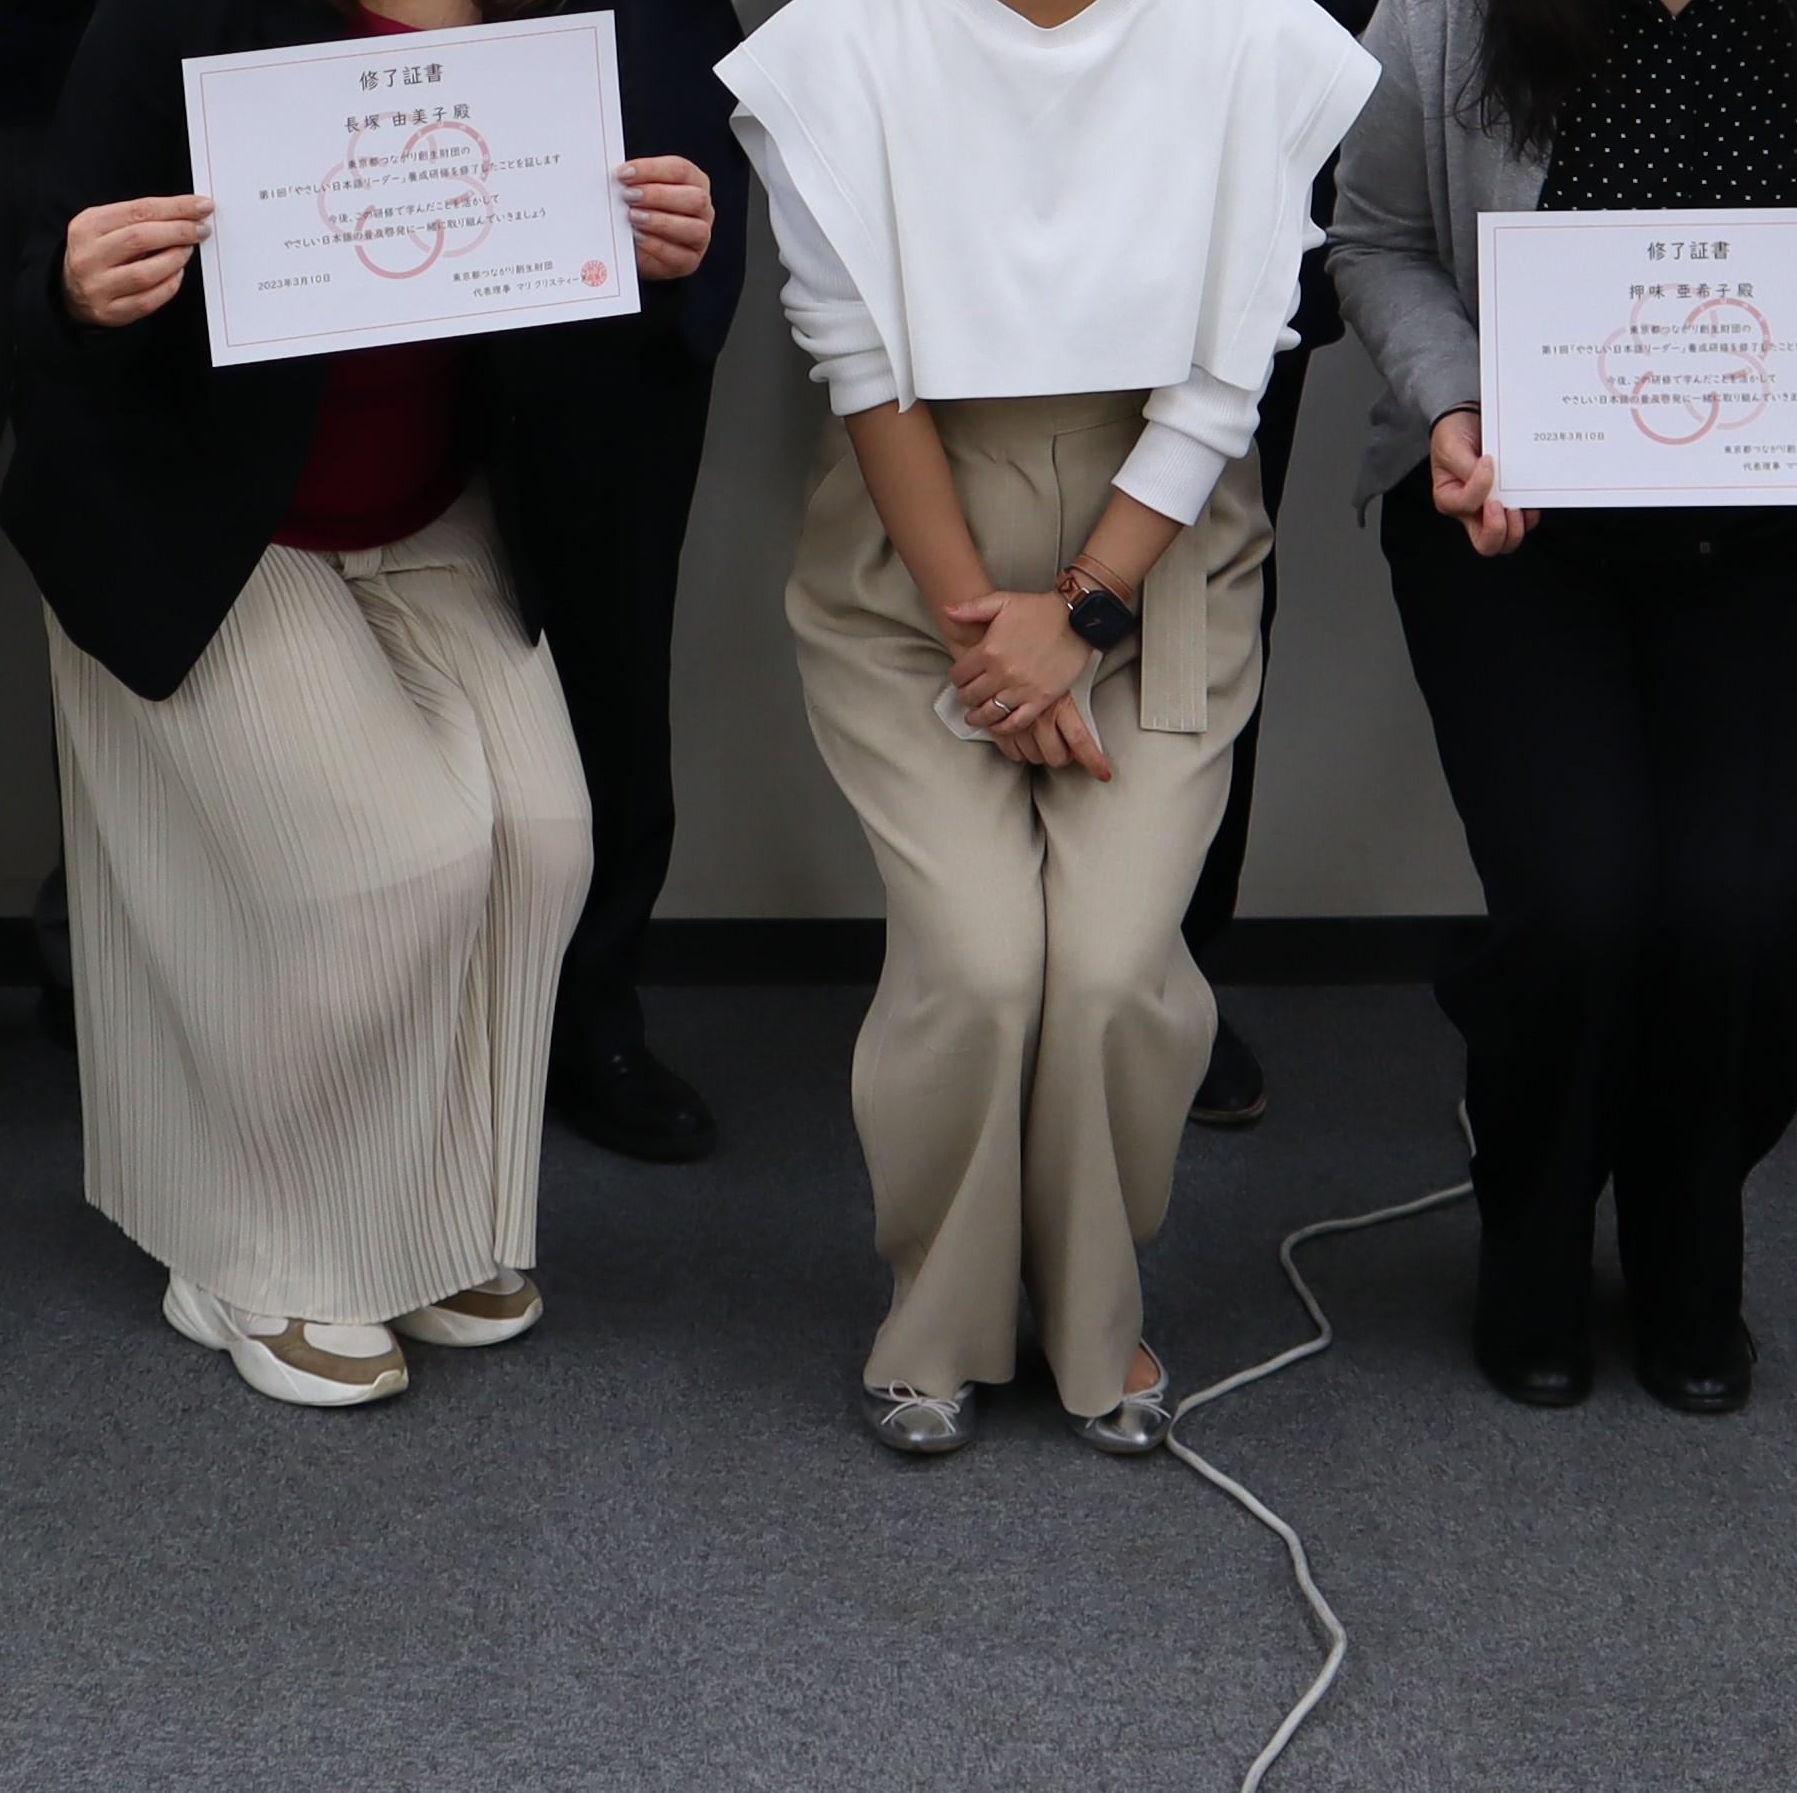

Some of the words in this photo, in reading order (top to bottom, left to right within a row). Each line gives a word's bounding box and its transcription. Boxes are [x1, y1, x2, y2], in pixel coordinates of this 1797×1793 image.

[360, 63, 442, 90] 修了証書
[346, 114, 380, 133] 長塚
[348, 147, 470, 169] 東京都つながり創生財団の
[1648, 241, 1729, 260] 修了証書
[453, 261, 552, 281] 東京都つながり創生財団
[258, 274, 330, 291] 2023年3月10日
[474, 285, 510, 296] 代表理事
[1630, 284, 1664, 299] 押味
[1630, 323, 1750, 335] 東京都つながり創生財団の
[1534, 432, 1604, 441] 2023年3月10日
[1743, 462, 1780, 470] 代表理事
